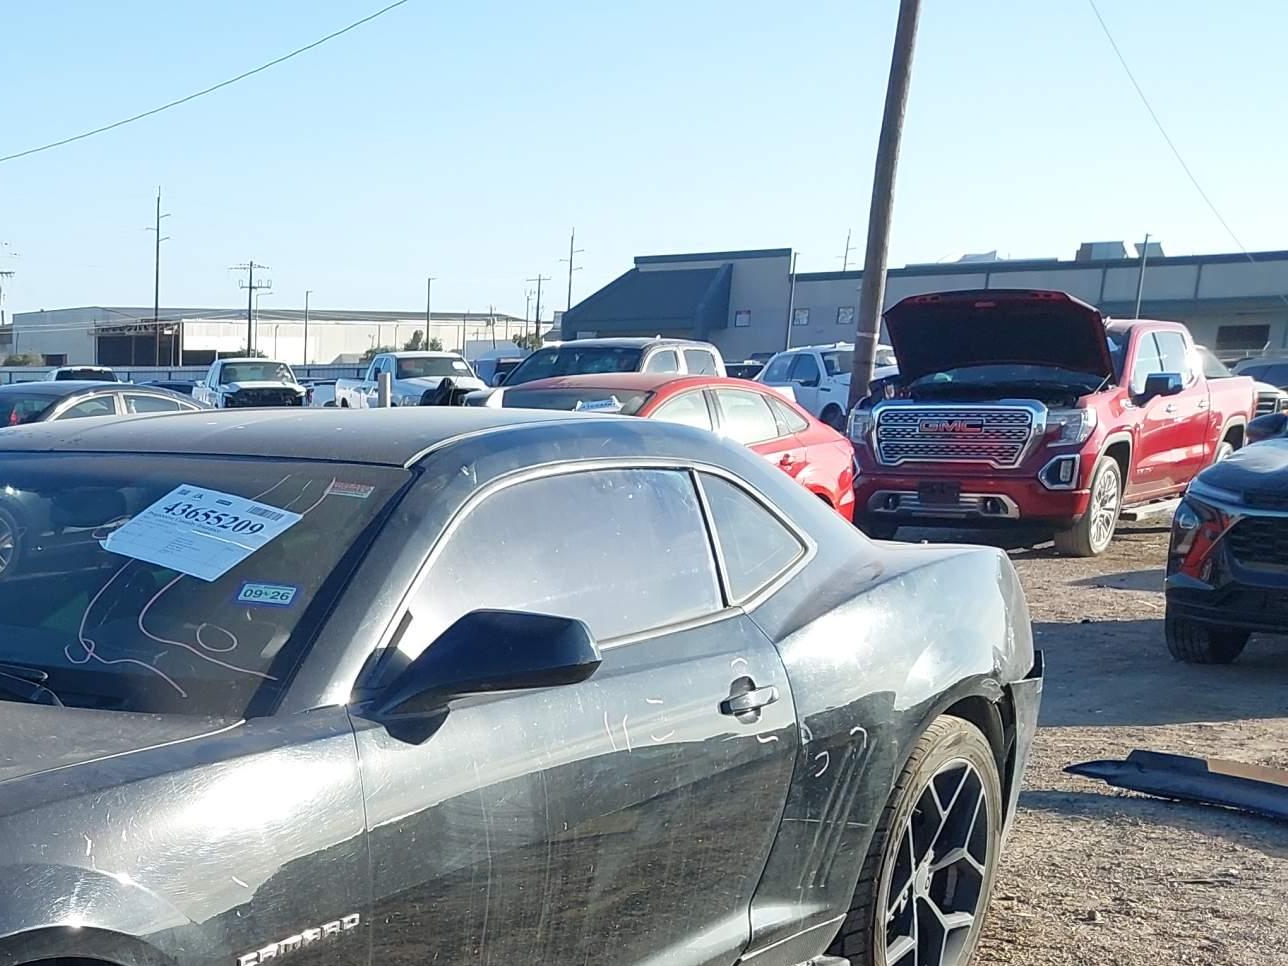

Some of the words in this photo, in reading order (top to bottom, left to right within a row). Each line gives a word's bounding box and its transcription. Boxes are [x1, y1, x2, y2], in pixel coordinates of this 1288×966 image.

[920, 419, 982, 433] GMC
[163, 501, 265, 535] 43655209
[243, 589, 263, 598] 09
[269, 591, 291, 601] 26
